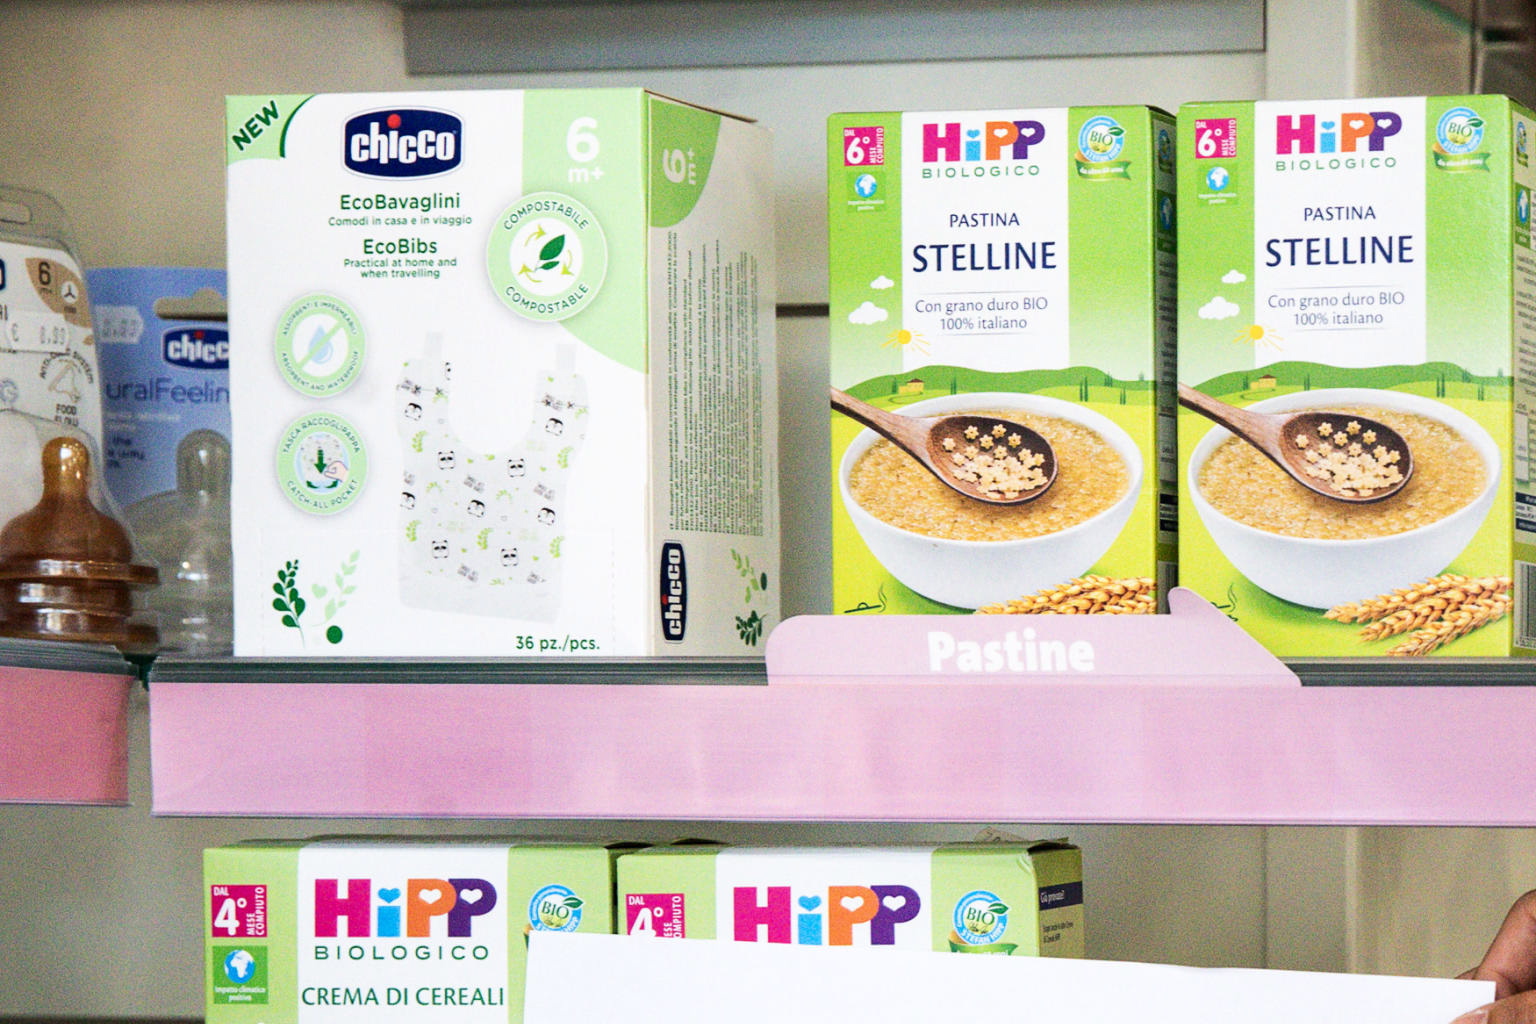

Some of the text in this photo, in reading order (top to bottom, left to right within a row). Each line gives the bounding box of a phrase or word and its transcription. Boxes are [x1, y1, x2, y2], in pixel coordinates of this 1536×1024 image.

[231, 100, 280, 152] NEW
[1276, 111, 1403, 155] HiPP
[1448, 122, 1473, 138] BIO
[350, 114, 457, 164] chicco
[566, 117, 600, 163] 6
[923, 120, 1046, 163] HiPP
[1090, 131, 1113, 146] BIO
[568, 163, 605, 184] m+
[922, 165, 1041, 179] BIOLOGICO
[1275, 157, 1397, 172] BIOLOGICO
[339, 193, 460, 213] EcoBavaglini
[328, 215, 473, 229] Comodi in casa e in viaggio
[503, 200, 589, 231] COMPOSTABILE
[949, 213, 1020, 228] PASTINA
[1303, 206, 1377, 222] PASTINA
[362, 238, 438, 255] EcoBibs
[1265, 235, 1414, 267] STELLINE
[343, 256, 457, 269] Practical at home and
[912, 241, 1057, 273] STELLINE
[38, 261, 51, 286] 6
[360, 268, 440, 281] when travelling
[505, 283, 589, 314] COMPOSTABLE
[915, 297, 1048, 315] Con grano duro BIO
[1268, 292, 1405, 312] Con grano duro BIO
[940, 315, 1028, 331] 100% italiano
[1294, 310, 1384, 326] 100% italiano
[283, 428, 301, 453] TASCA
[331, 479, 358, 505] POCKET
[661, 547, 683, 636] chicco
[515, 634, 600, 652] 36 pz./pcs.
[927, 627, 1095, 673] Pastine
[213, 887, 230, 896] DAL
[628, 896, 646, 906] DAL
[255, 887, 265, 936] COMPIUTO
[314, 878, 498, 938] HiPP
[541, 901, 570, 919] BIO
[672, 896, 682, 939] OMPIUTO
[733, 884, 922, 946] HiPP
[966, 907, 996, 925] BIO
[246, 913, 256, 936] MESE
[663, 922, 673, 937] ESE
[314, 945, 490, 961] BIOLOGICO
[301, 986, 504, 1007] CREMA DI CEREALI
